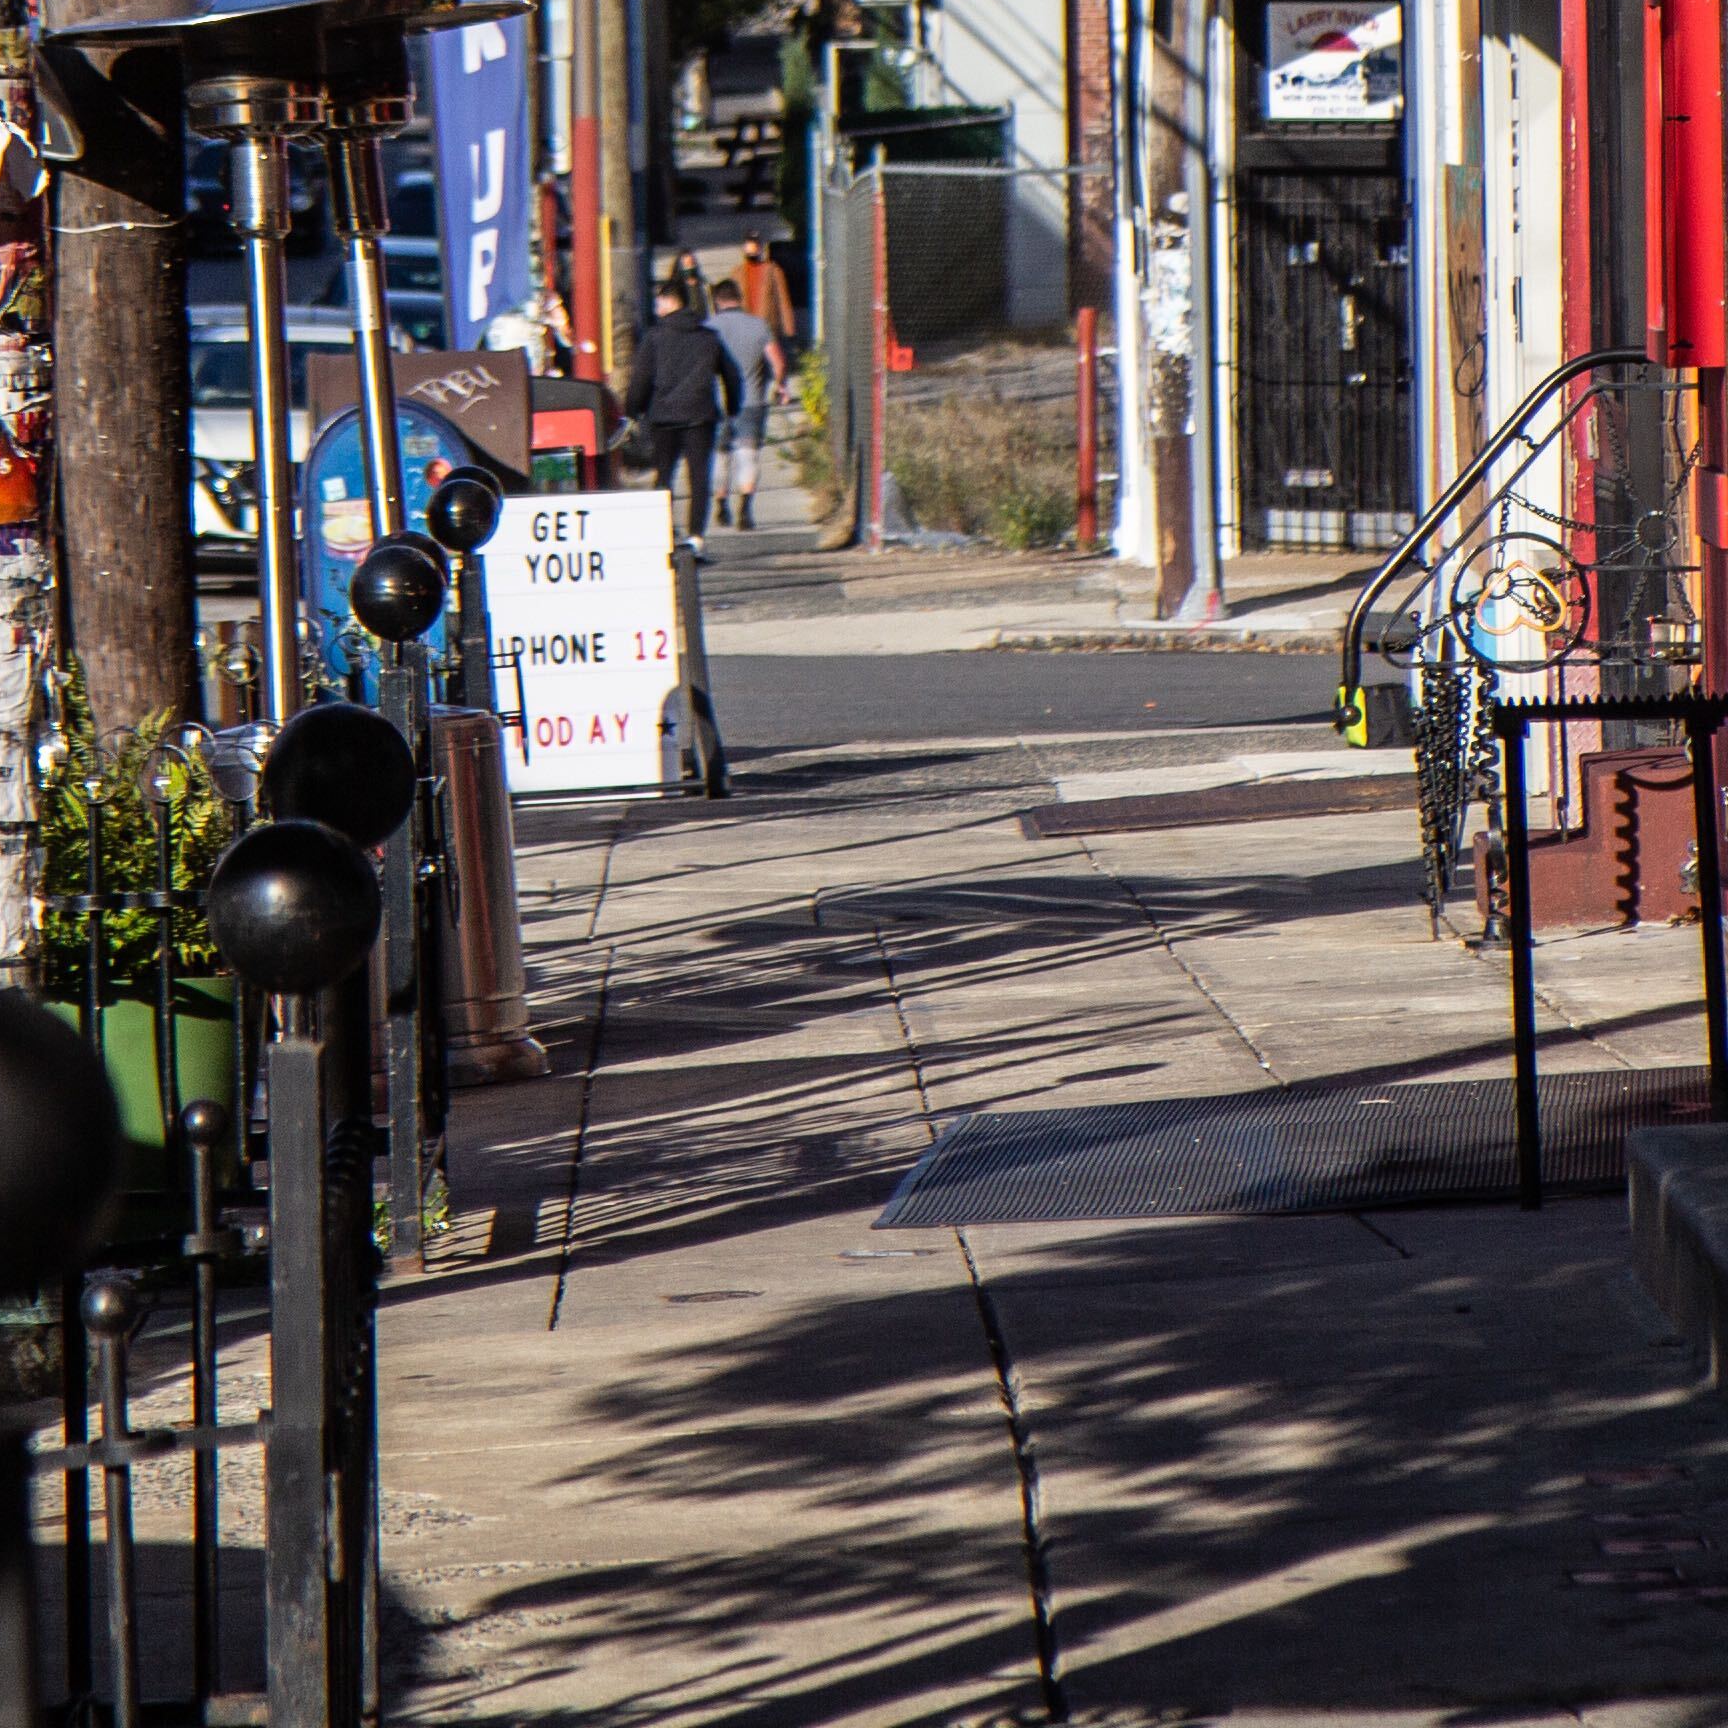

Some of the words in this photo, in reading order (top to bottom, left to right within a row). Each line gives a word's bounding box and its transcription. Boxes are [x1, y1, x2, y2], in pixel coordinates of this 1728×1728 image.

[532, 510, 591, 542] GET
[525, 551, 606, 584] YOUR
[498, 632, 607, 667] IPHONE
[634, 629, 669, 662] 12
